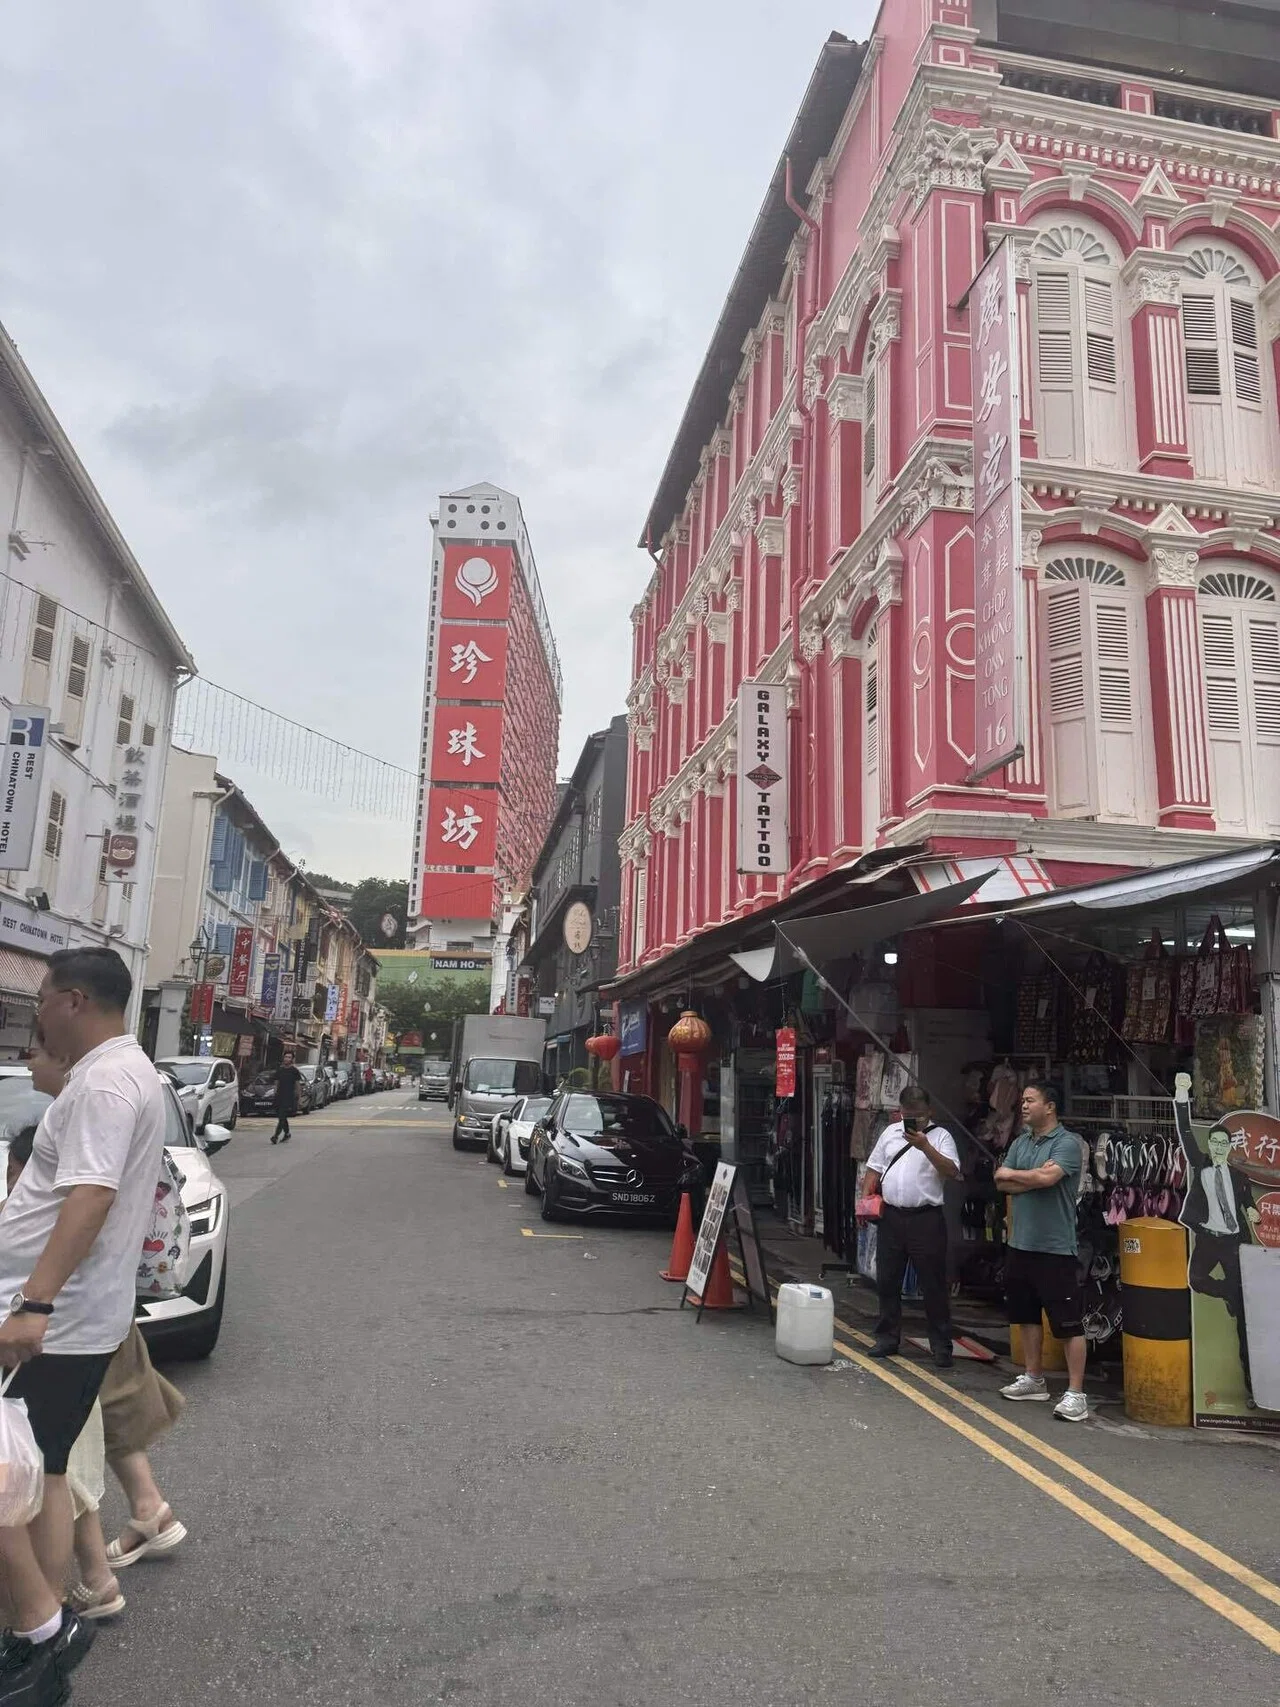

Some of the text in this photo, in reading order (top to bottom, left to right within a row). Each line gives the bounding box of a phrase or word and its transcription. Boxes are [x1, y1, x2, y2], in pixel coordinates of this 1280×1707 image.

[983, 588, 1007, 622] CHOP
[978, 612, 1012, 655] KWONG
[984, 651, 1006, 678] ONN
[982, 677, 1008, 708] TONG
[441, 640, 493, 850] 珍珠坊
[757, 690, 770, 762] GALAXY
[984, 712, 1009, 754] 16
[5, 751, 20, 813] CHINATOWN
[25, 752, 36, 780] REST
[757, 792, 771, 867] TATTOO
[2, 916, 17, 930] REST
[20, 922, 48, 940] CHINATOWN
[435, 960, 458, 968] NAM
[460, 960, 475, 969] HO
